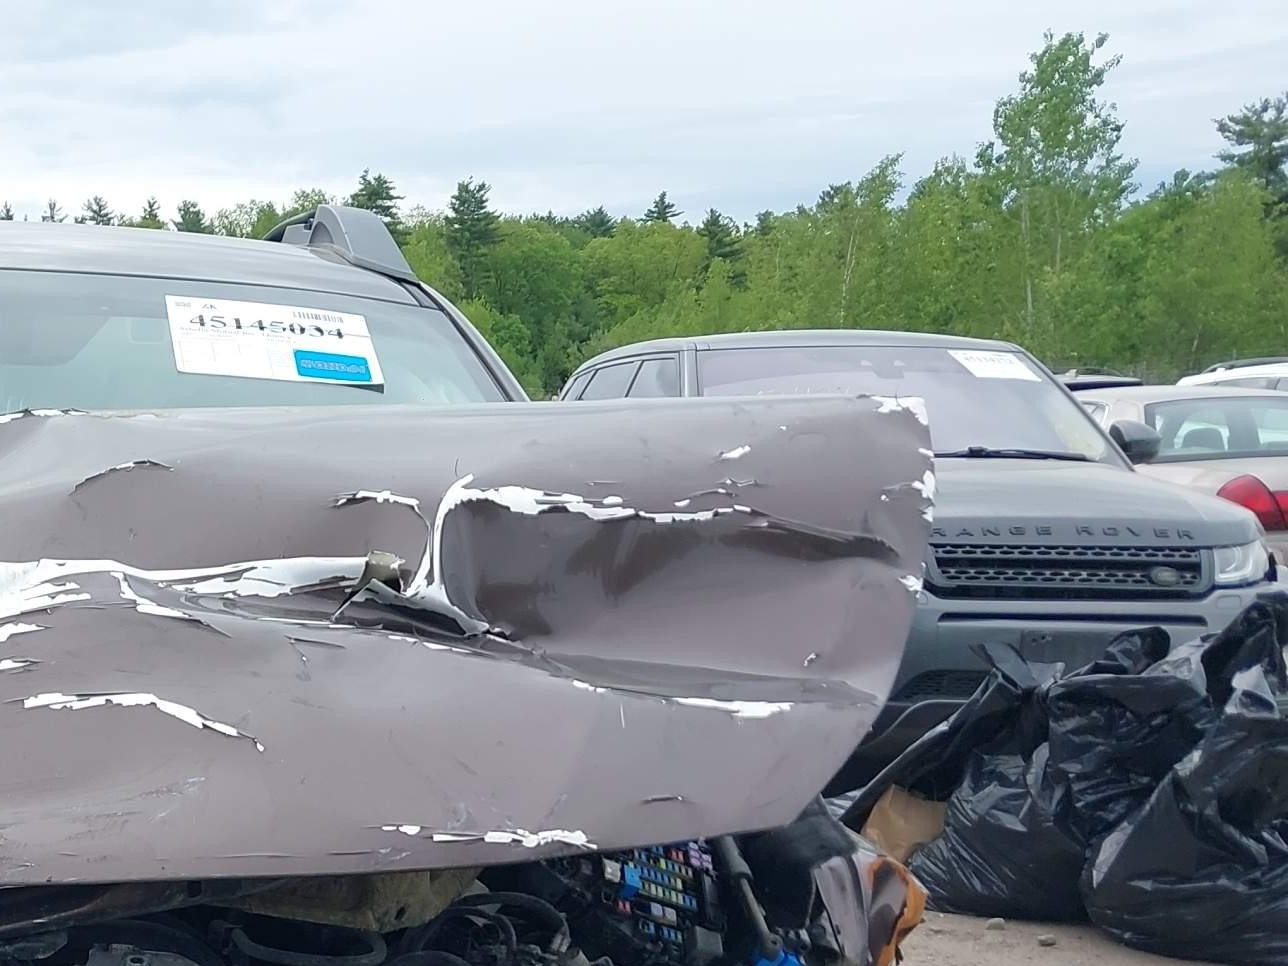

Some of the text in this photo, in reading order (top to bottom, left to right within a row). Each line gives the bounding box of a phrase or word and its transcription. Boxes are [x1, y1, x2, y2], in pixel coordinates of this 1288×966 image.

[190, 314, 344, 339] 45145034
[929, 525, 1195, 540] RANGE ROVER
